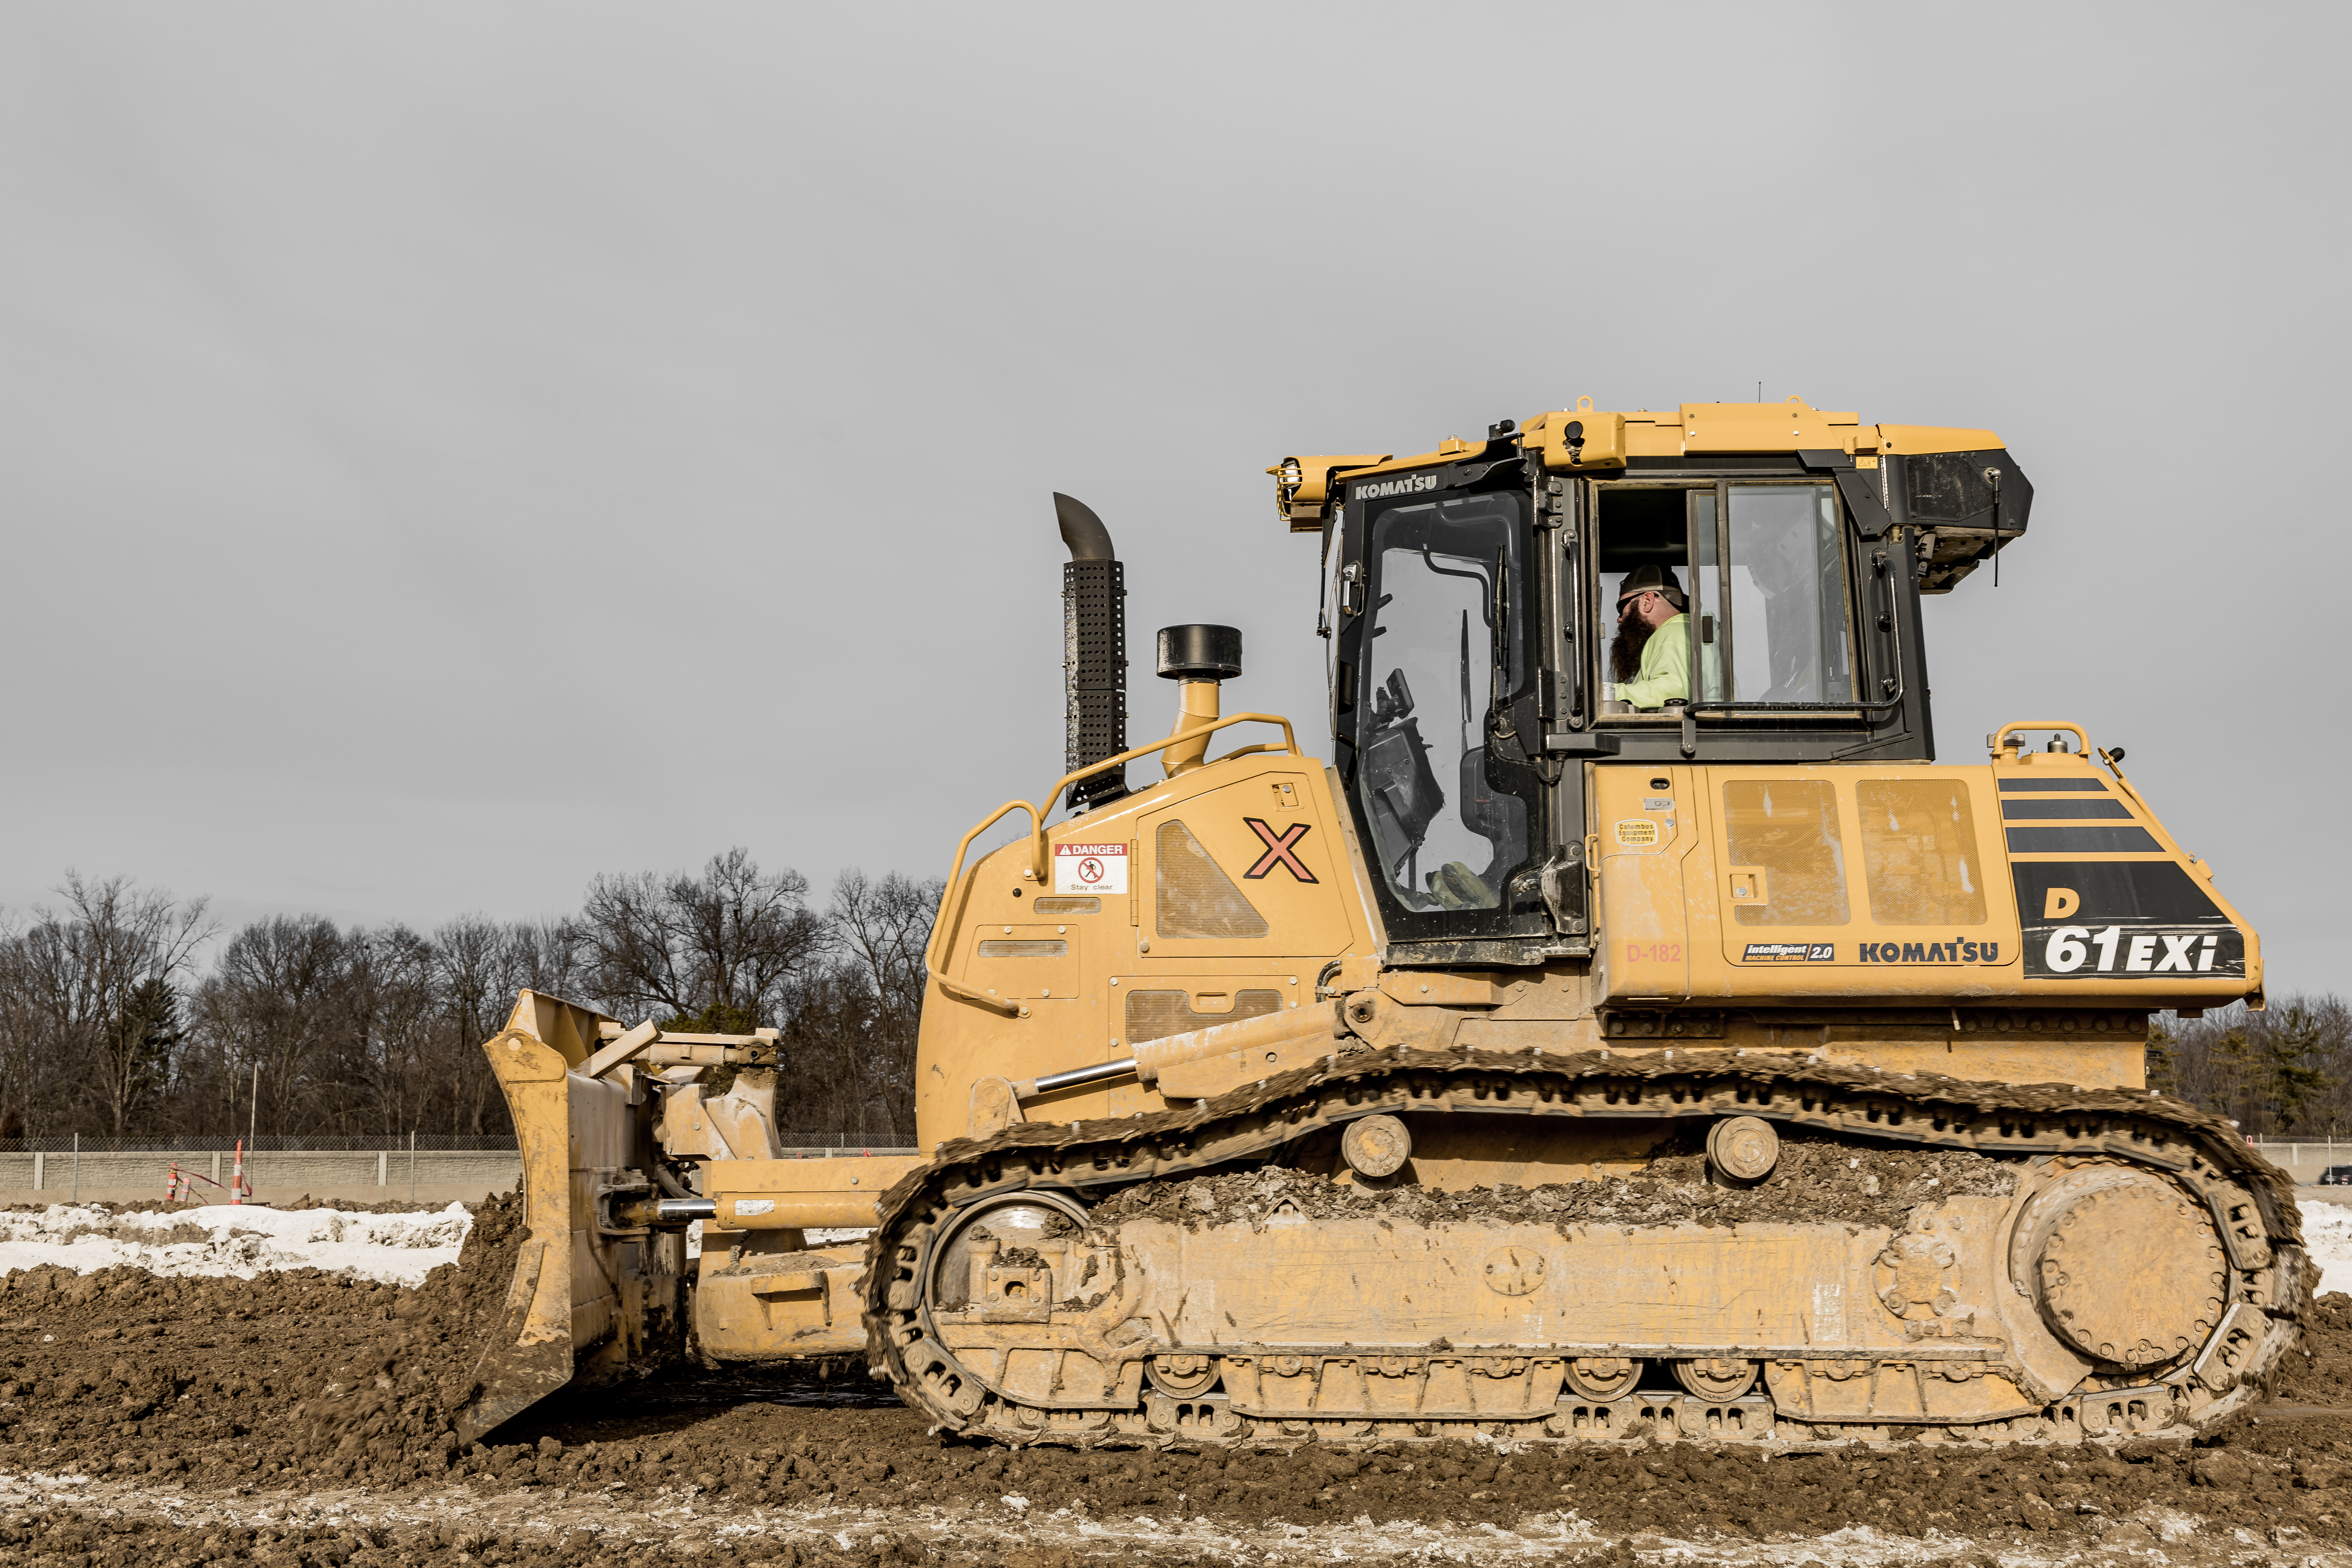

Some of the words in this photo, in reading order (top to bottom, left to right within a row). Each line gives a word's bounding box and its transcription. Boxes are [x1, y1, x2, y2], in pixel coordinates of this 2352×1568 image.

[1355, 474, 1437, 499] KOMATSU
[1073, 845, 1123, 854] DANGER
[1243, 817, 1320, 884] X
[2044, 888, 2080, 919] D
[1627, 944, 1681, 962] D-182
[1747, 945, 1807, 956] intelligent
[1810, 946, 1833, 959] 2.0
[1859, 937, 1998, 962] KOMATSU
